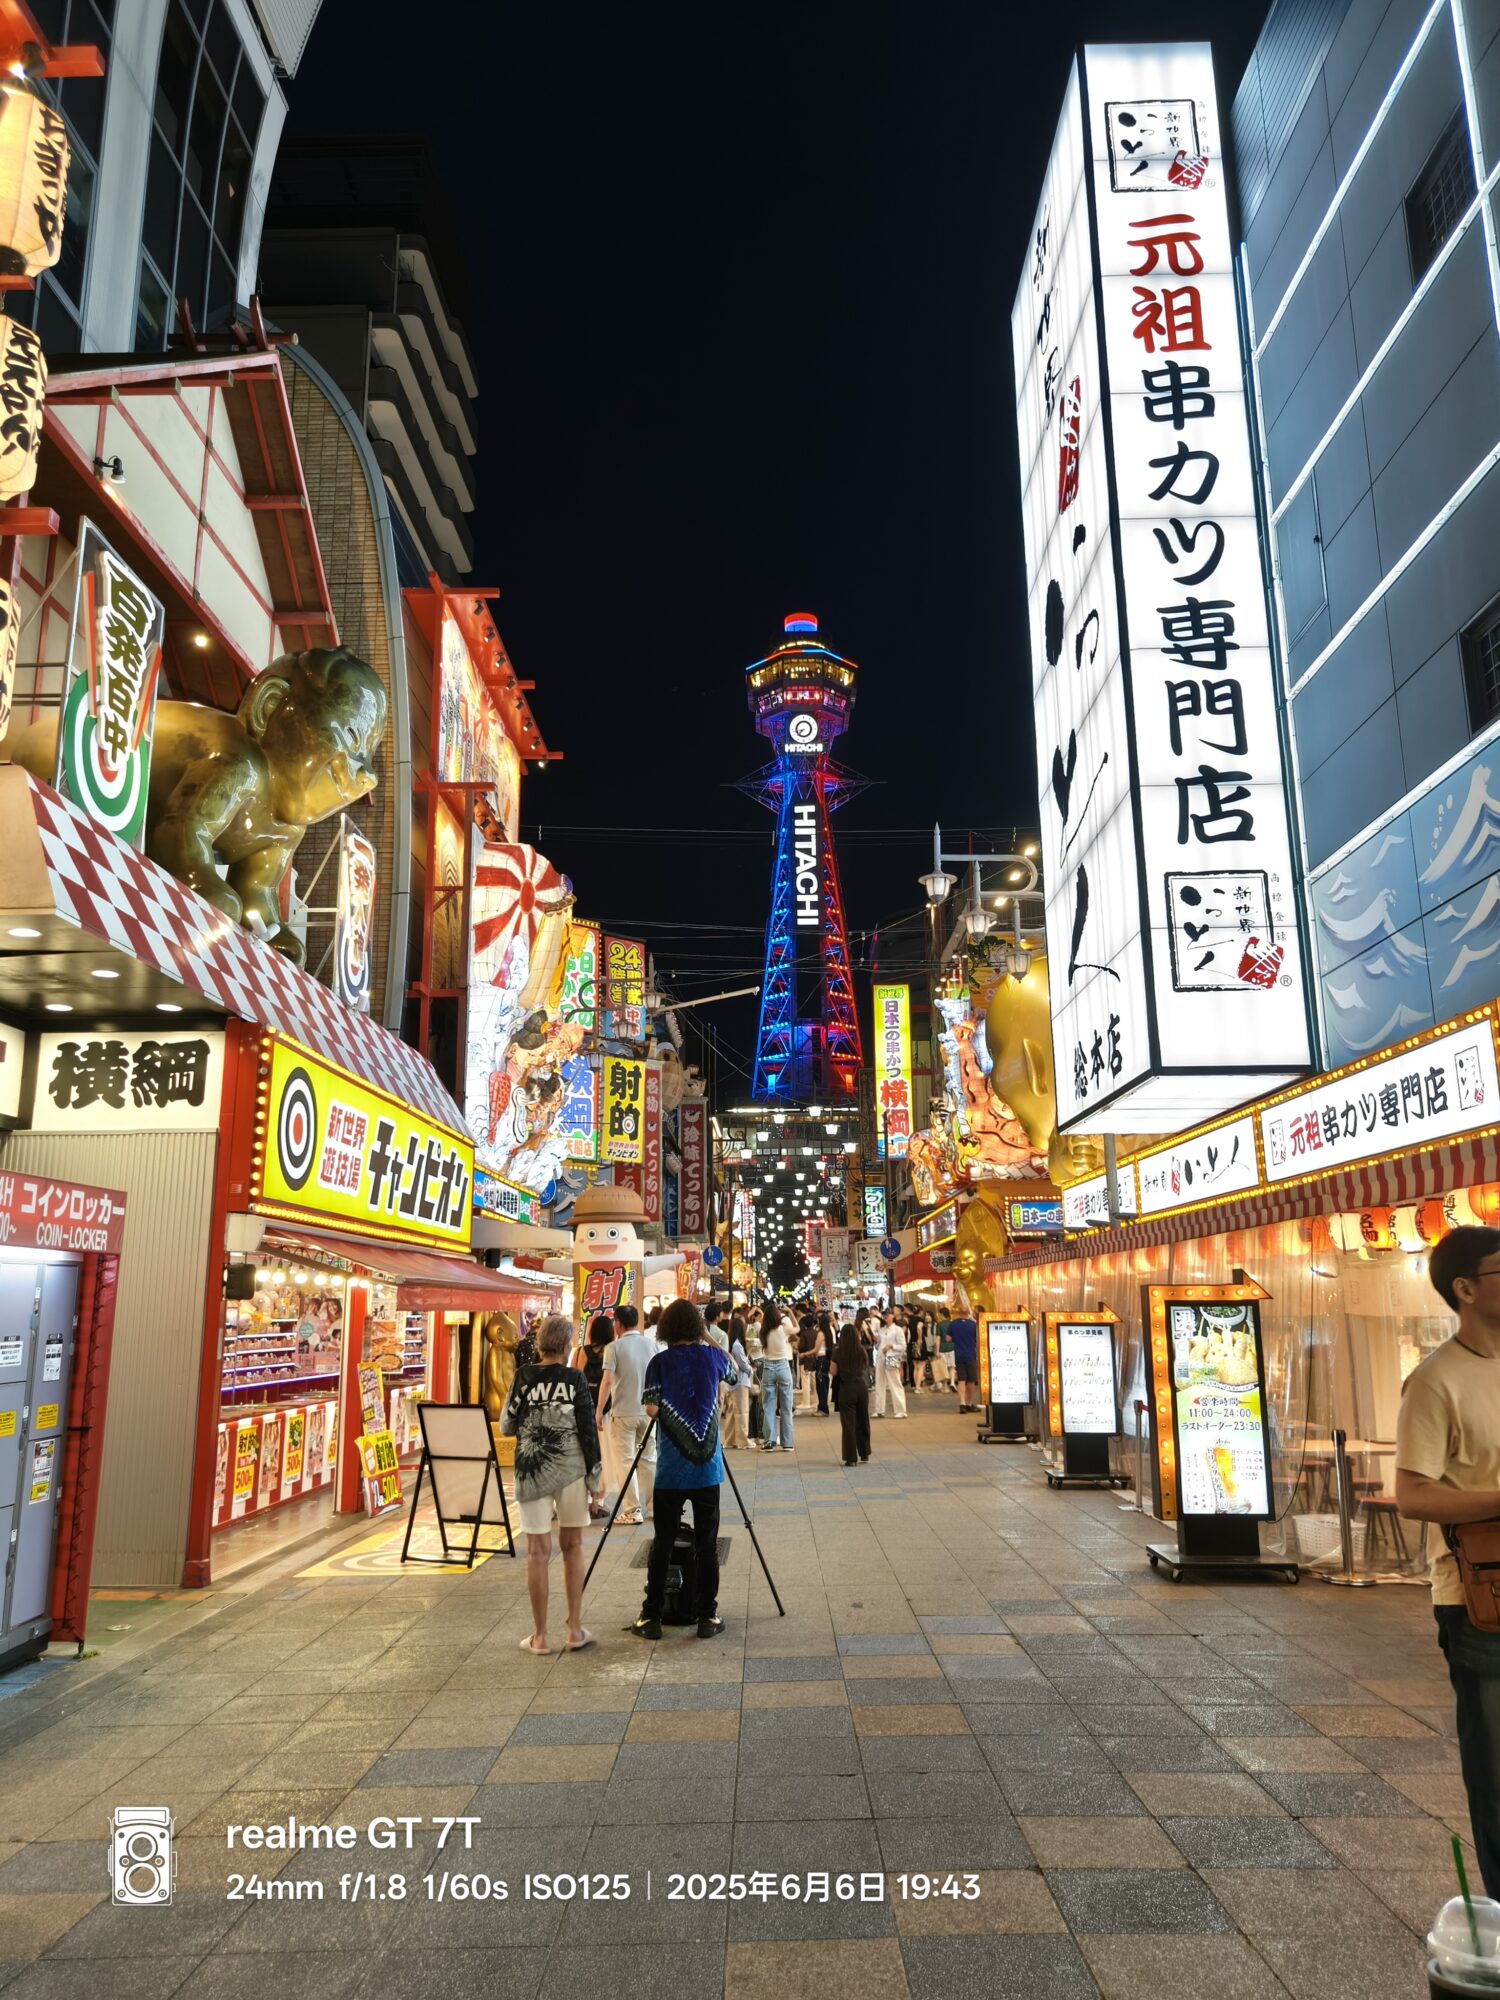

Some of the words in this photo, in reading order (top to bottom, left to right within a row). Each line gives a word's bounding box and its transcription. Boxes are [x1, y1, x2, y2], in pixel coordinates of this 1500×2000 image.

[1127, 213, 1256, 845] 元祖串カツ専門店
[104, 556, 153, 764] 百発百中
[785, 743, 823, 753] HITACHI
[793, 804, 820, 926] HITACHI
[49, 1039, 210, 1109] 横綱
[884, 1000, 901, 1079] 日本一の串かつ
[1074, 1014, 1122, 1097] 総本店
[328, 1105, 367, 1151] 新世界
[609, 1061, 642, 1141] 射的
[880, 1079, 909, 1137] 横綱
[1289, 1066, 1449, 1157] 元祖串カツ専門店
[21, 1182, 125, 1225] コインロッカー
[319, 1147, 362, 1191] 遊技場
[369, 1120, 469, 1228] チャンピオン
[36, 1221, 108, 1251] COIN-LOCKER
[1201, 1396, 1239, 1407] 営業時間
